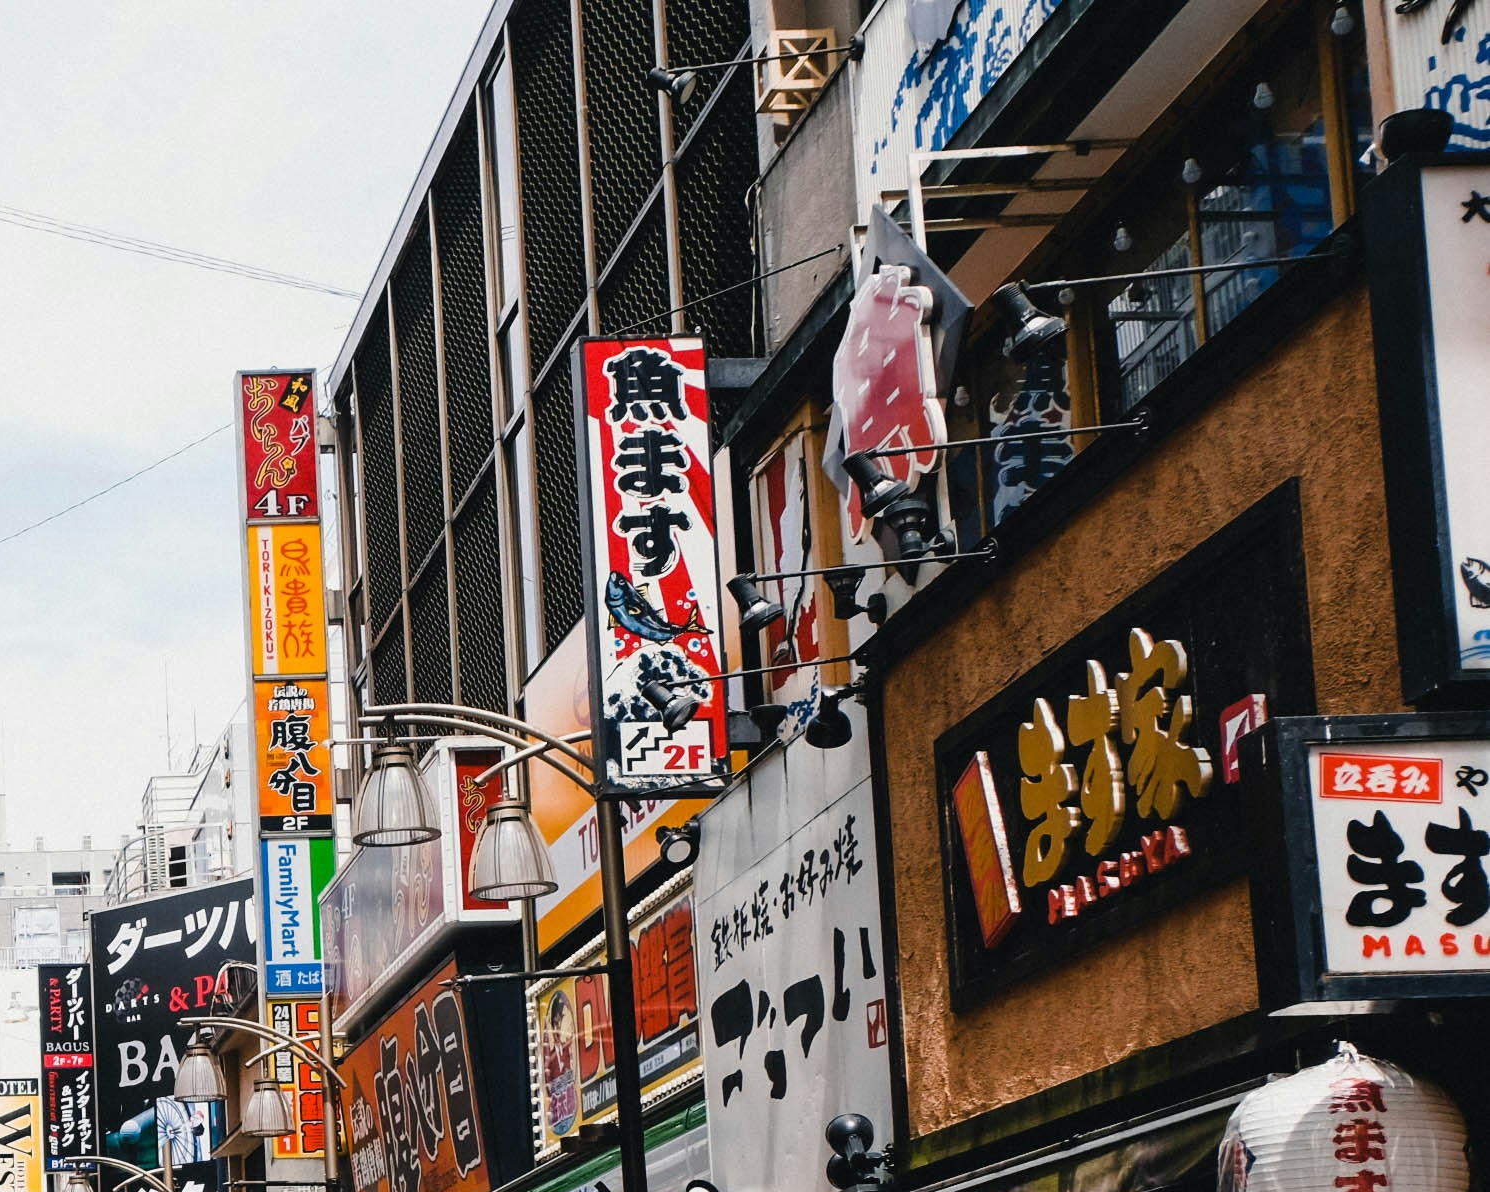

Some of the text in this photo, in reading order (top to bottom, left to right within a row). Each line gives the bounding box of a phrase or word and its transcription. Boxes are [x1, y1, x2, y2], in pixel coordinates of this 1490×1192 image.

[282, 376, 308, 413] 和風
[290, 416, 310, 455] パブ
[605, 346, 692, 576] 魚ます
[254, 490, 310, 516] 4F
[261, 539, 274, 654] TORIKIZOKU
[268, 714, 320, 812] 腹八分目
[664, 745, 705, 769] 2F
[1333, 762, 1430, 794] 立呑み
[282, 817, 309, 830] 2F
[1346, 806, 1490, 927] ます
[278, 844, 300, 957] FamilyMart
[275, 970, 292, 987] 酒
[66, 965, 85, 1040] ダーツバー
[46, 1040, 90, 1053] BAGUS
[76, 1070, 93, 1155] インターネット
